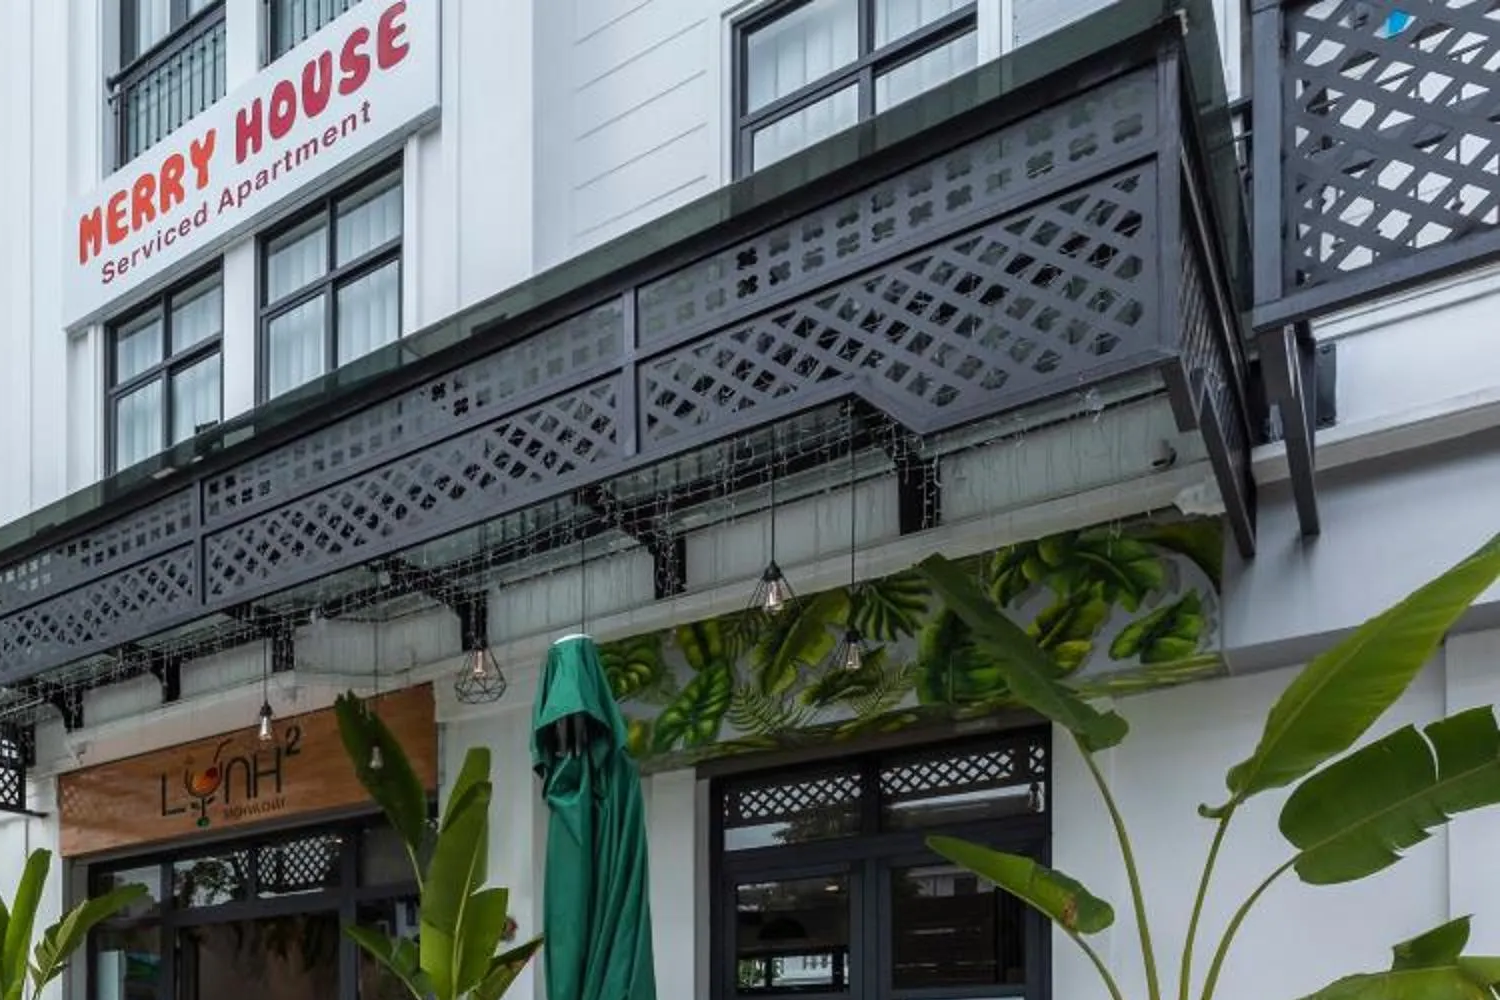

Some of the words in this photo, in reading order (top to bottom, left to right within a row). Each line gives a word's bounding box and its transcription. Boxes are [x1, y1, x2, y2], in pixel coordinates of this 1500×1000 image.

[79, 128, 216, 265] MERRY
[235, 3, 411, 164] HOUSE
[101, 202, 208, 285] Serviced
[217, 101, 372, 217] Apartment
